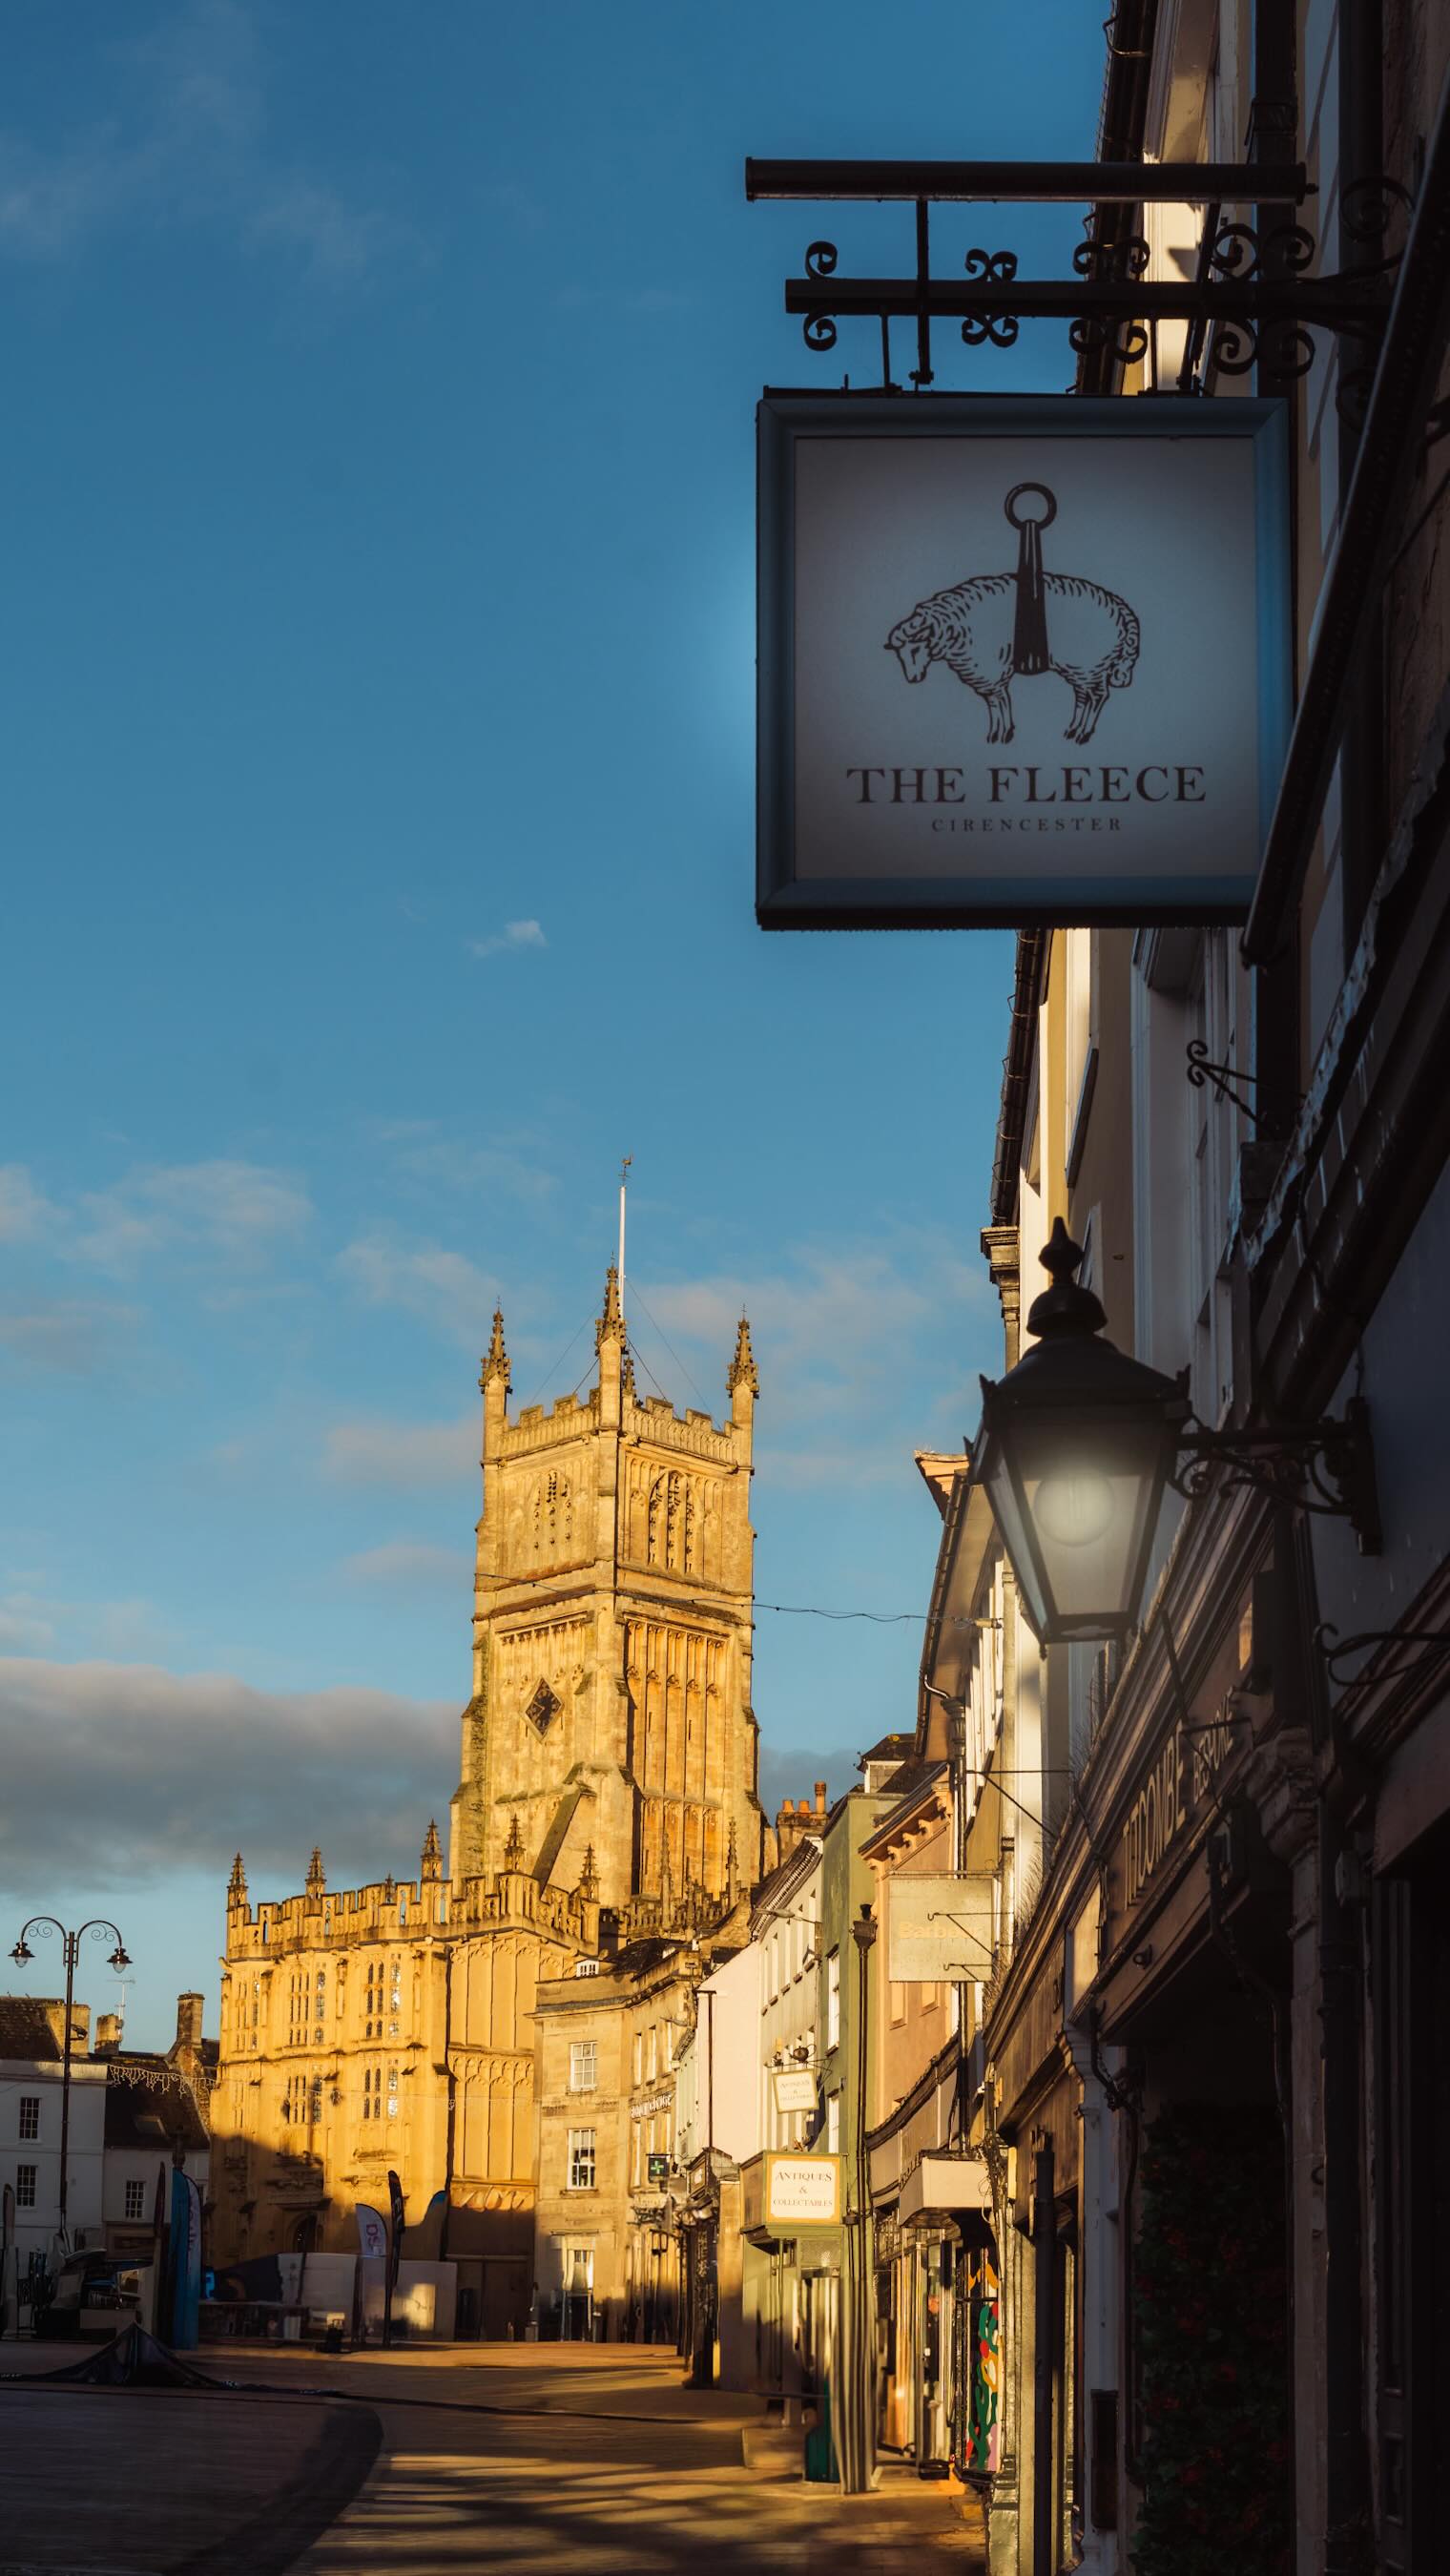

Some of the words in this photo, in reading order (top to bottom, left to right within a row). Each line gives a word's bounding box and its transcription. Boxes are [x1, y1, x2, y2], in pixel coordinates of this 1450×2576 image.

[846, 766, 966, 804] THE
[986, 765, 1207, 803] FLEECE
[931, 817, 1122, 832] CIRENCESTER
[776, 2171, 832, 2182] ANTIQUES
[798, 2185, 808, 2194] &
[773, 2198, 833, 2208] COLLECTABLES
